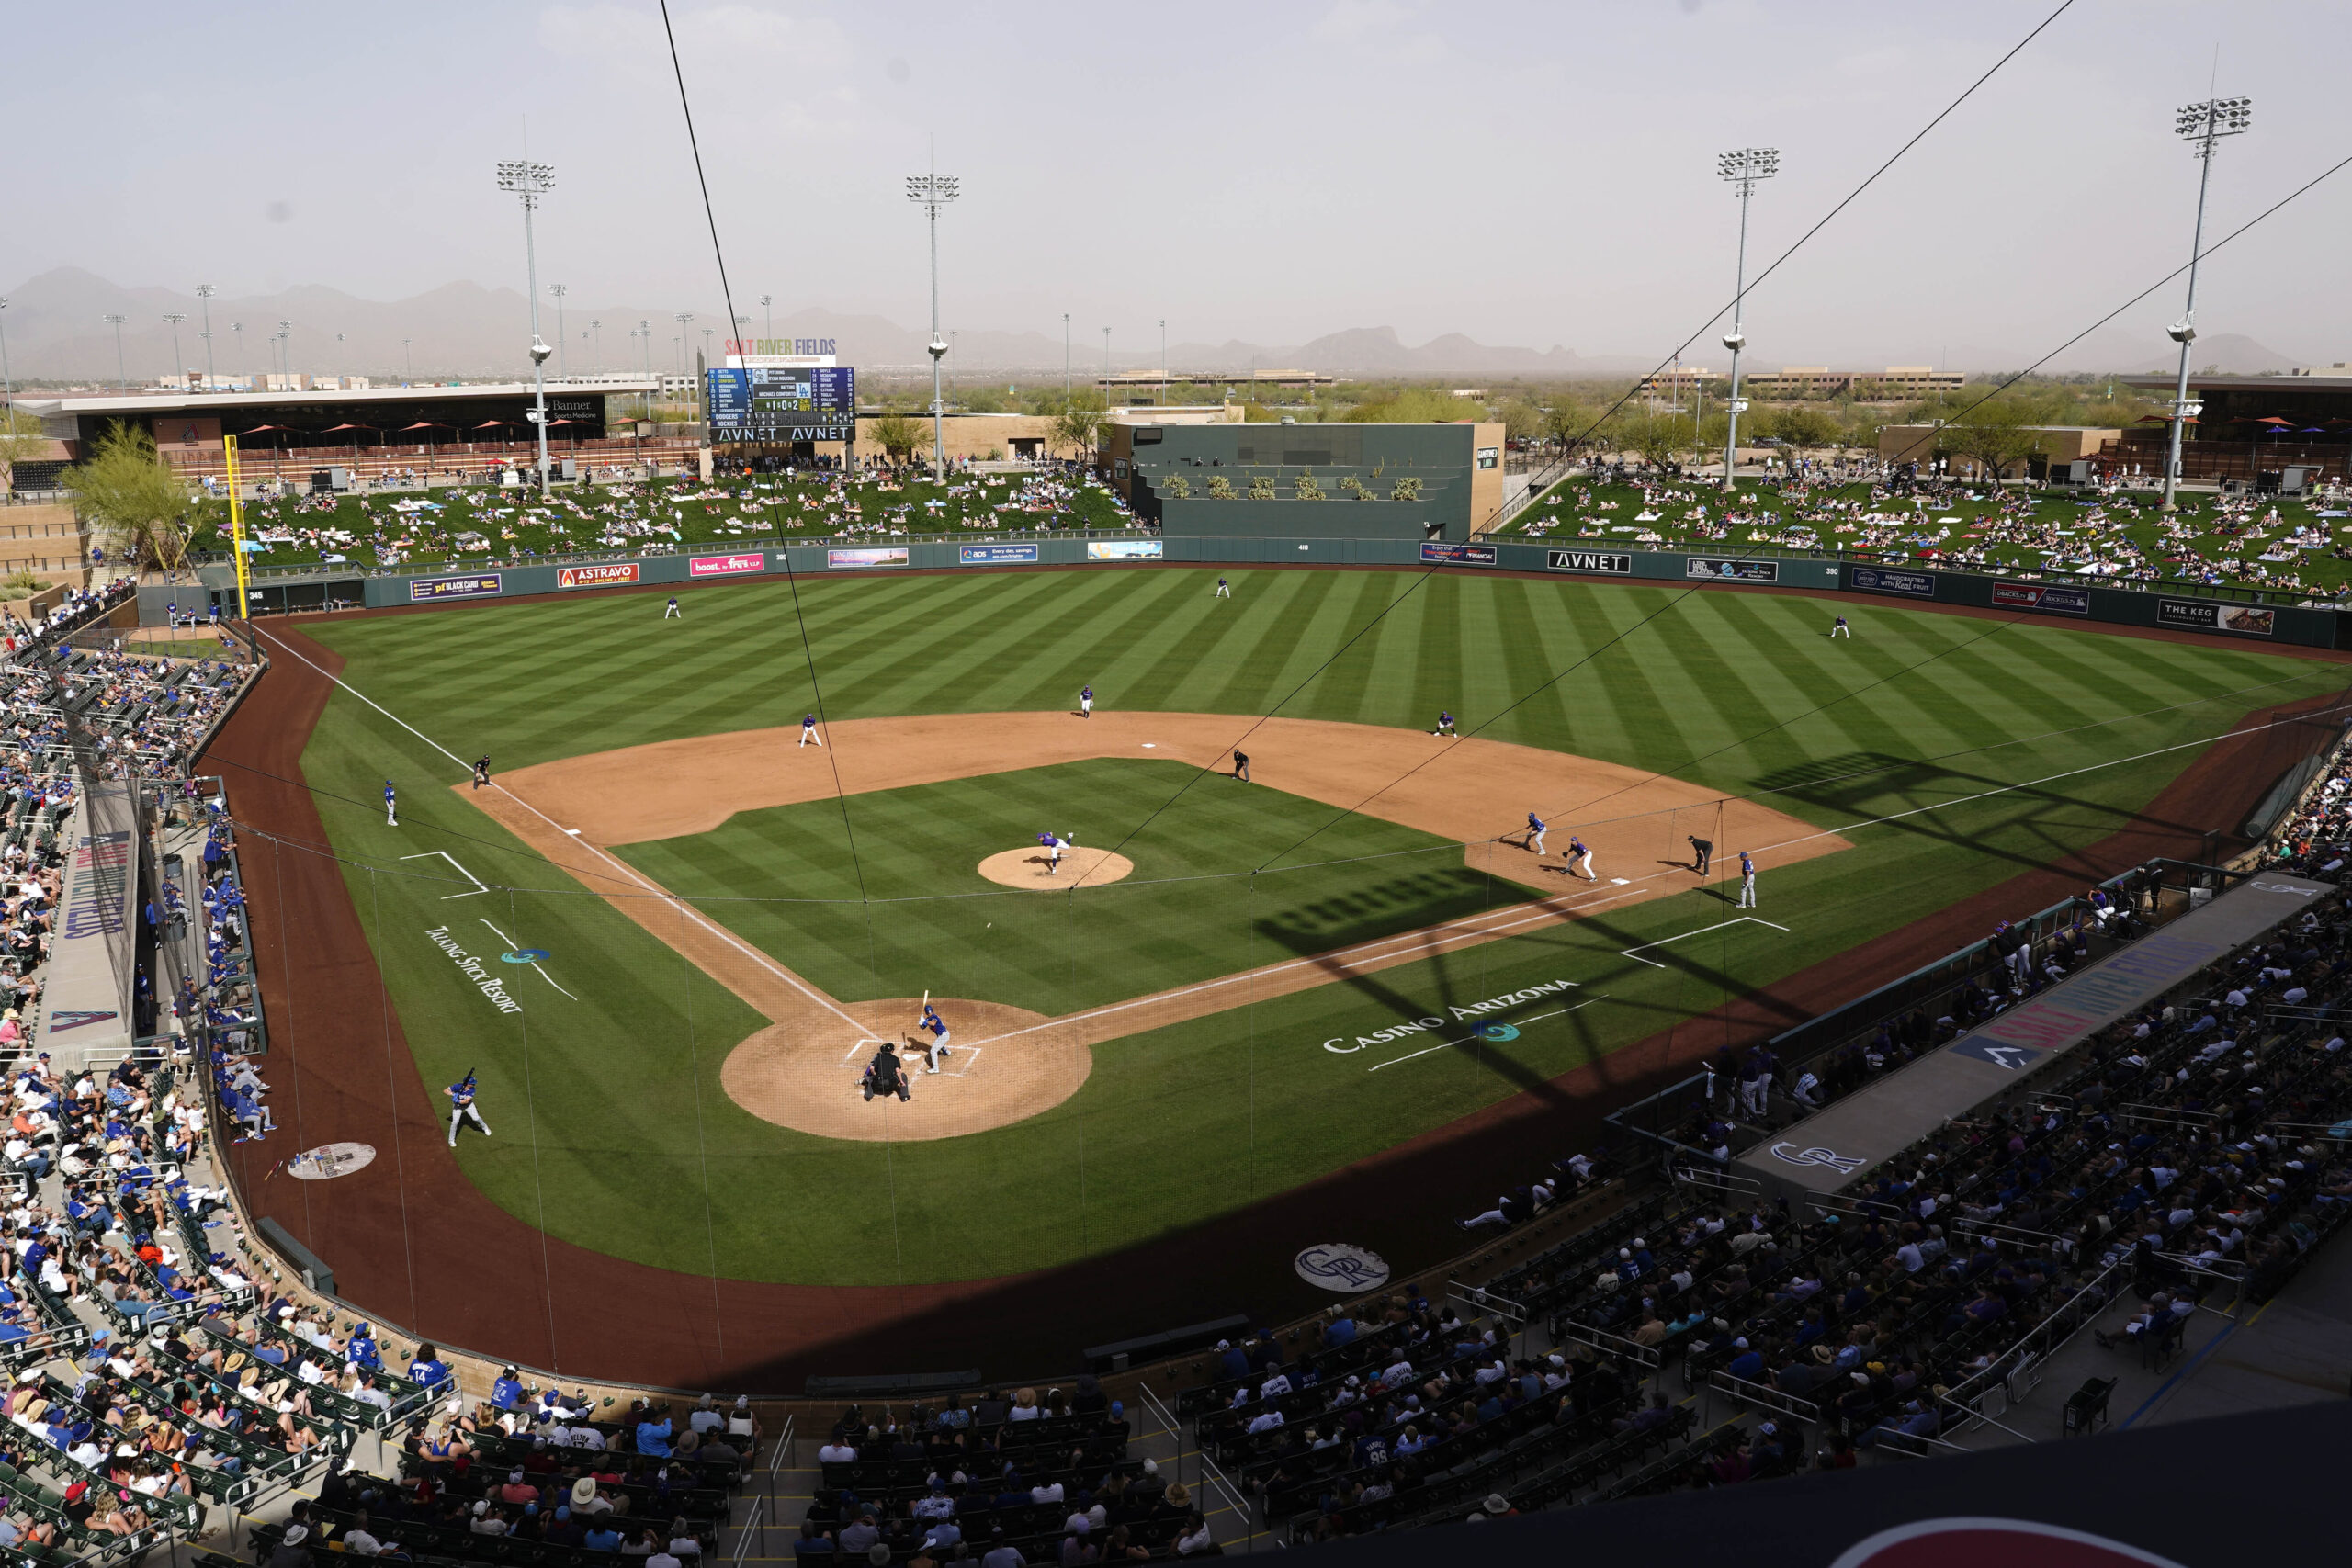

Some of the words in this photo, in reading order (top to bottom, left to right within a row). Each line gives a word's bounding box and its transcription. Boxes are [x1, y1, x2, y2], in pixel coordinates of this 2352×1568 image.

[725, 339, 753, 355] SALT
[757, 339, 793, 355] RIVER
[795, 339, 836, 355] FIELDS
[553, 400, 591, 411] Banner
[782, 400, 787, 410] 0
[793, 400, 798, 410] 2
[719, 428, 776, 442] AVNET
[792, 427, 848, 440] AVNET
[695, 561, 721, 571] boost.
[1556, 553, 1622, 570] AVNET
[578, 567, 631, 581] ASTRAVO
[1885, 574, 1926, 584] HANDCRAFTED
[435, 582, 447, 594] pf
[446, 581, 464, 591] BLACK
[463, 580, 479, 589] CARD
[1894, 580, 1912, 590] Real
[249, 591, 263, 600] 345
[2165, 604, 2187, 615] THE
[2190, 607, 2211, 616] KEG
[76, 843, 129, 869] SALT
[64, 896, 125, 940] FIELDS
[2104, 935, 2220, 981] FIELDS
[424, 925, 468, 958] TALKING
[455, 956, 491, 982] STICK
[476, 977, 522, 1014] RESORT
[2041, 971, 2149, 1016] RIVER
[1323, 1016, 1445, 1054] CASINO
[1448, 979, 1581, 1021] ARIZONA
[1990, 1003, 2096, 1048] SALT
[356, 1347, 362, 1356] 5
[415, 1371, 426, 1383] 14
[571, 1434, 590, 1444] HELTON
[1370, 1450, 1388, 1464] 99
